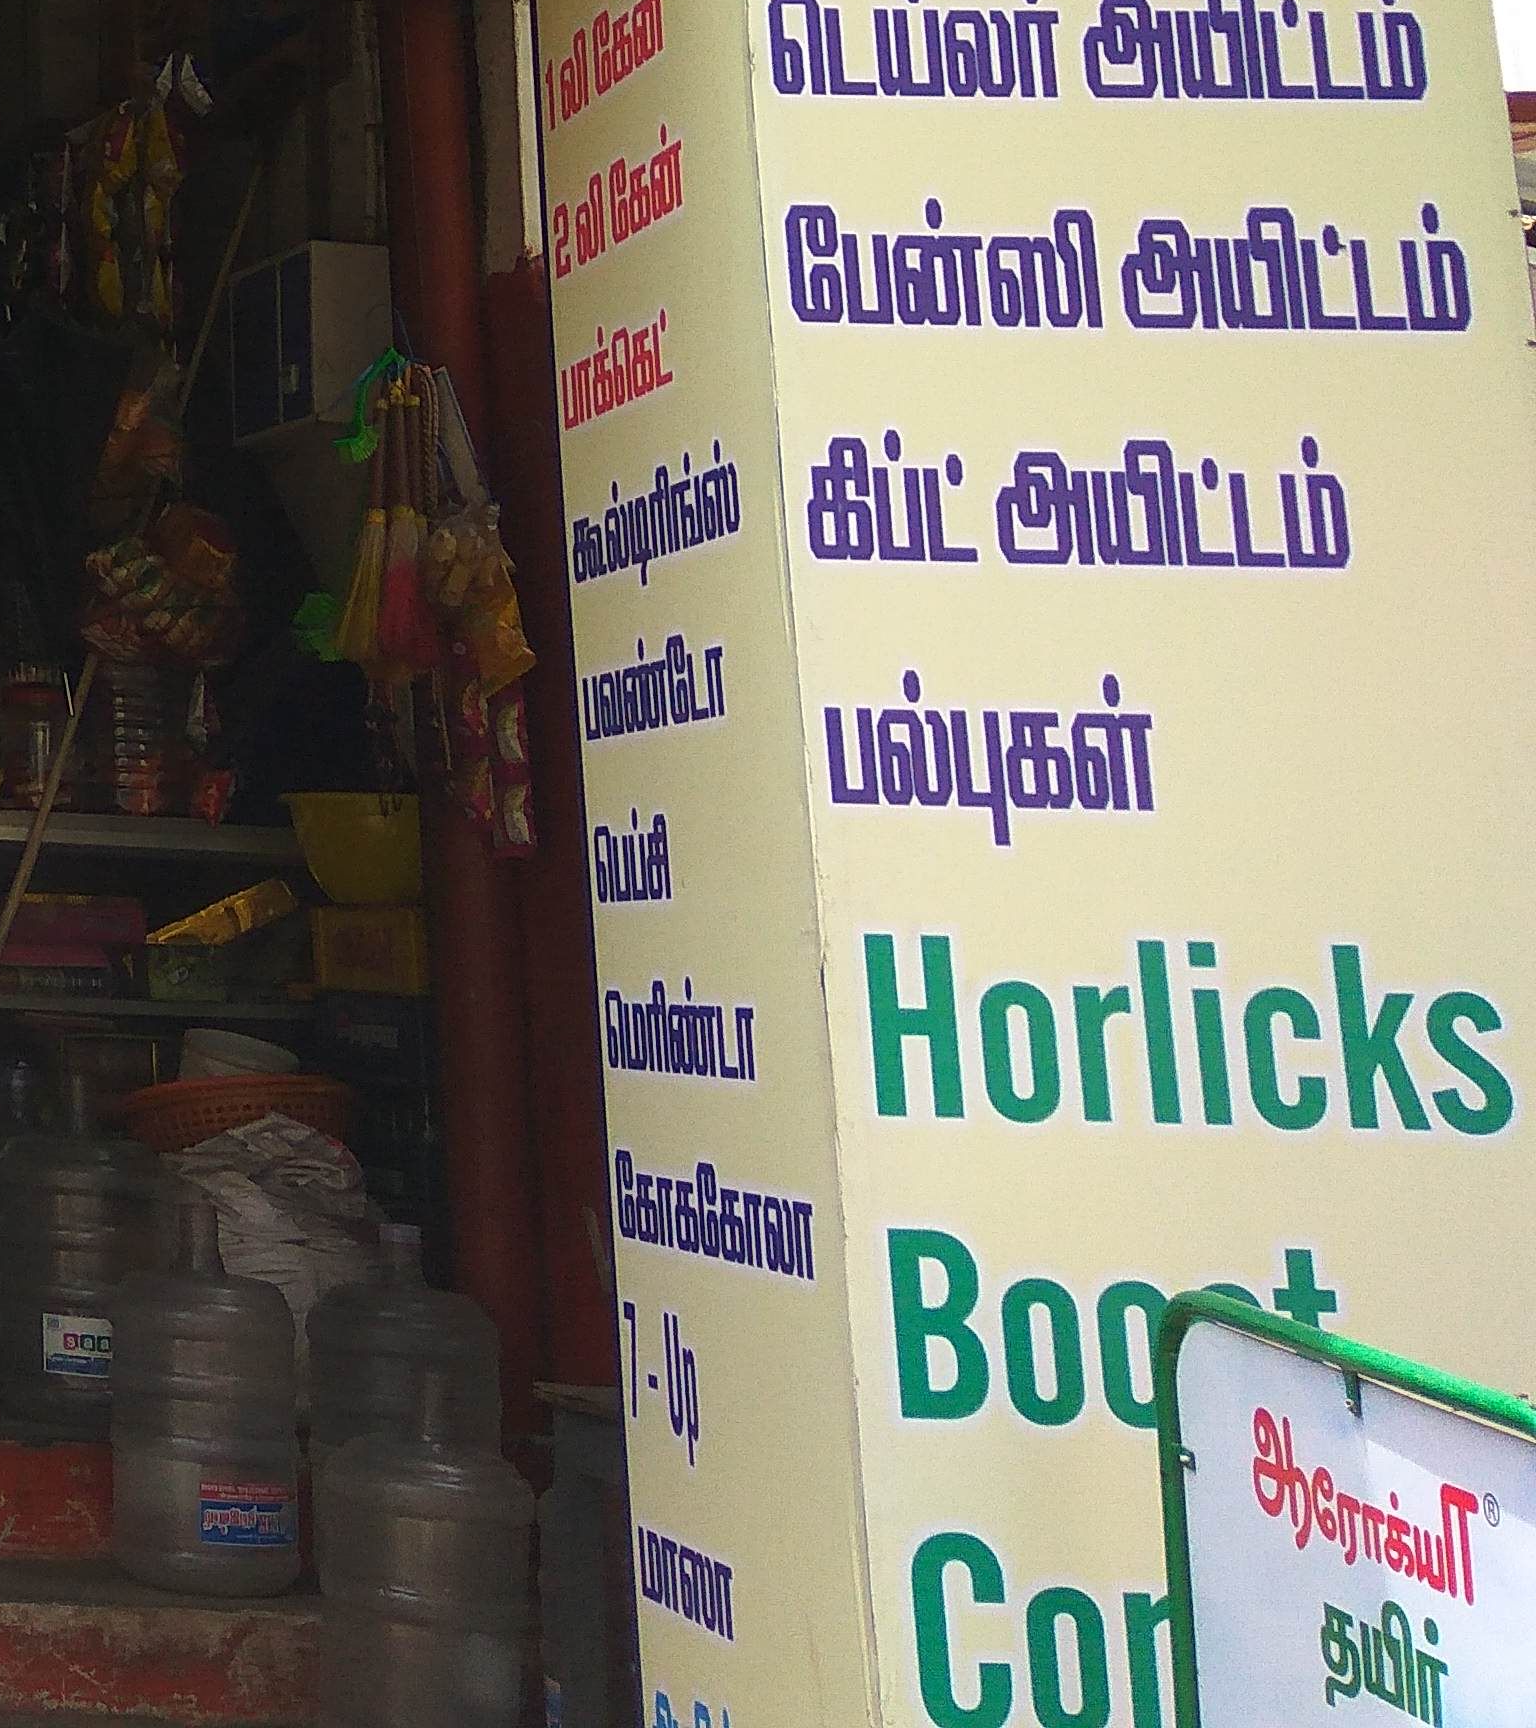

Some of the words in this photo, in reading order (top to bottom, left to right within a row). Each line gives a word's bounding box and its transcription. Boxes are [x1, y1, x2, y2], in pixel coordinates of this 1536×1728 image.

[545, 59, 556, 130] 1
[554, 201, 571, 280] 2
[609, 122, 683, 244] கேன்
[784, 197, 1104, 330] பேன்ஸி
[1121, 201, 1472, 332] அயிட்டம்
[561, 308, 673, 431] பாக்கெட்
[807, 428, 978, 563] கிப்ட்
[996, 435, 1350, 569] அயிட்டம்
[583, 634, 725, 741] பவண்டோ
[824, 669, 1154, 847] பல்புகள்
[594, 807, 672, 903] பெப்சி
[863, 932, 1515, 1136] Horlicks
[1321, 1599, 1449, 1728] தயிர்
